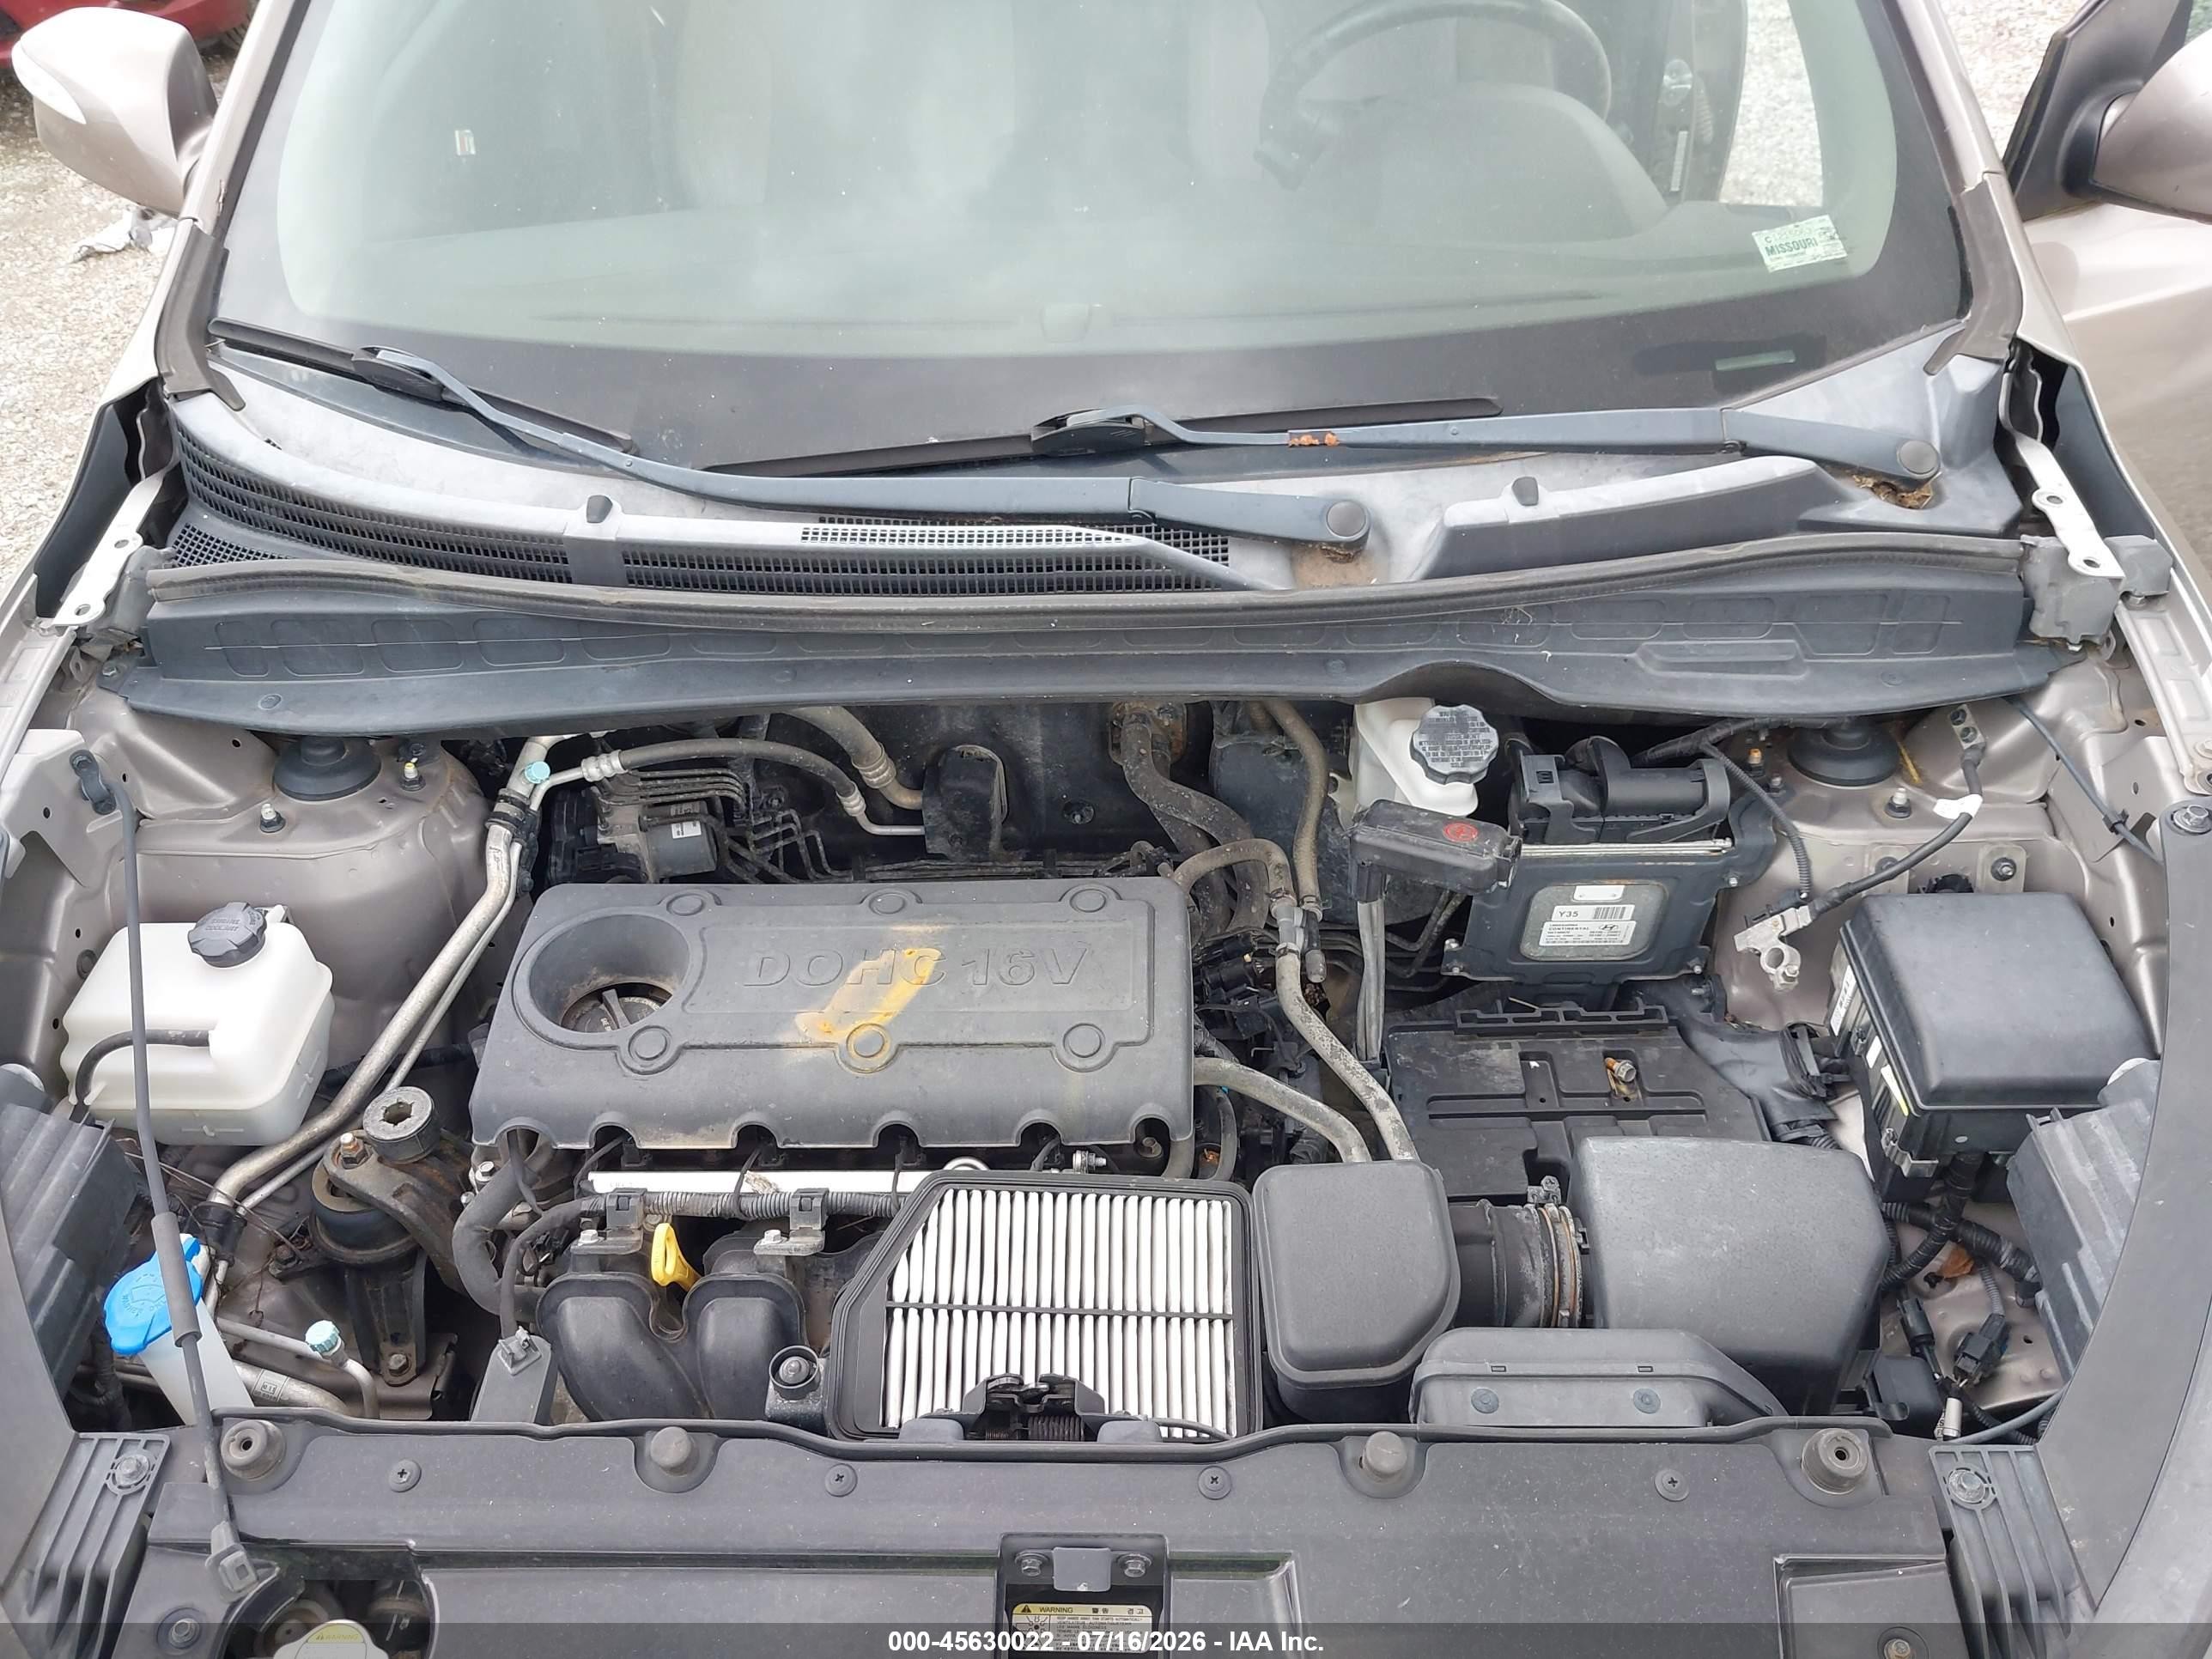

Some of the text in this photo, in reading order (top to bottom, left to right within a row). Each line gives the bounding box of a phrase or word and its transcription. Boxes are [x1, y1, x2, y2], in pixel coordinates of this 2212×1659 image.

[1765, 237, 1819, 256] MISSOURI
[744, 948, 1088, 987] DOHC 16V
